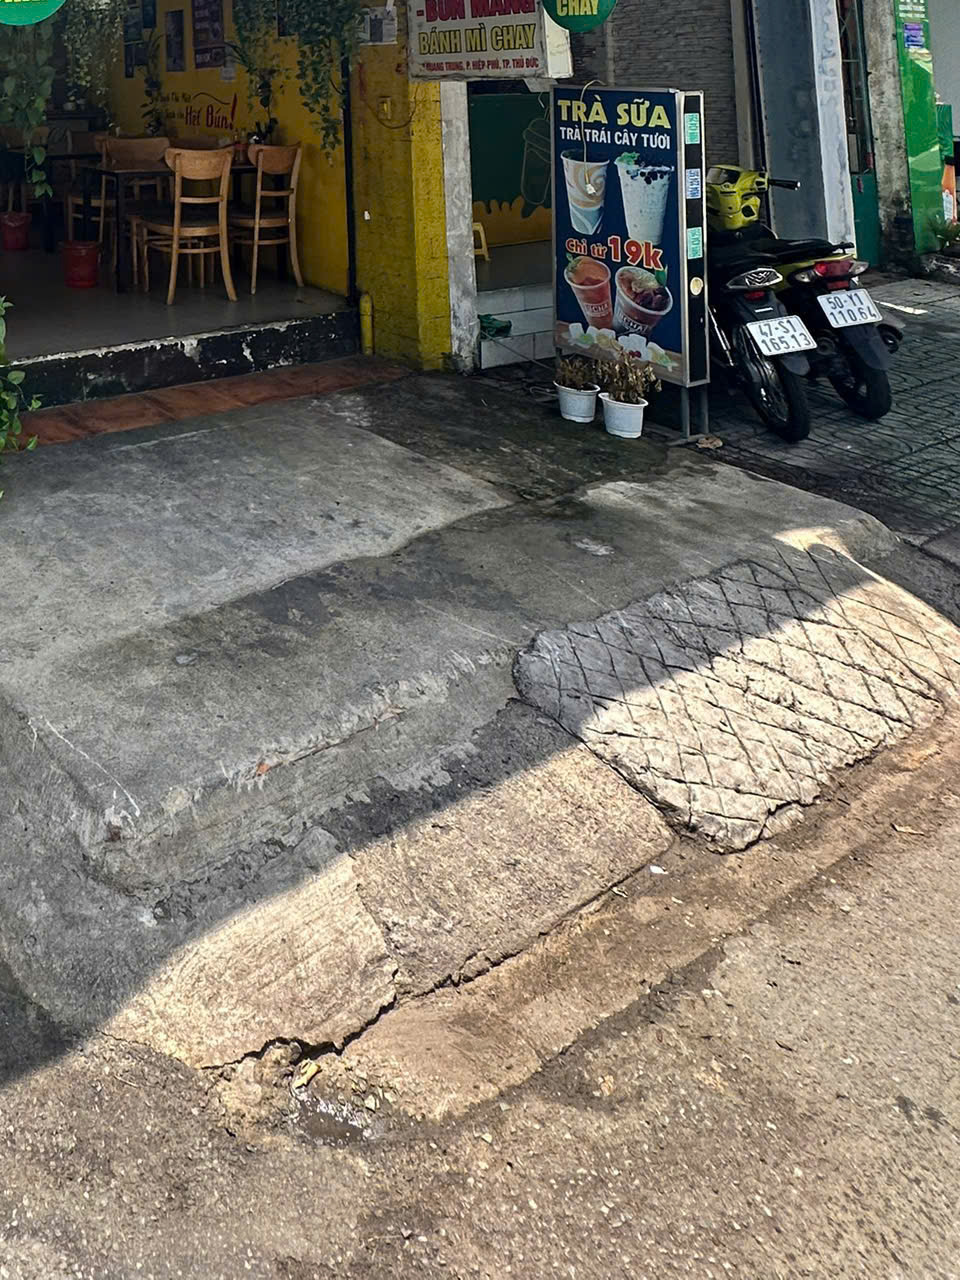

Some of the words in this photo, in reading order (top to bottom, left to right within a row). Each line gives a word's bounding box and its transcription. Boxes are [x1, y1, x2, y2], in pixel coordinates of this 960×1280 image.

[418, 26, 461, 55] BÁNH
[466, 23, 487, 52] MÌ
[491, 23, 536, 51] CHAY
[557, 94, 608, 124] TRÀ
[617, 98, 672, 129] SỮA
[560, 125, 581, 141] TRÀ
[584, 127, 611, 144] TRÁI
[614, 129, 638, 146] CÂY
[641, 132, 670, 149] TƯƠI
[608, 235, 664, 269] 19k
[826, 293, 863, 311] 50-Y1
[758, 320, 799, 338] 47-S1
[761, 332, 812, 353] 165.13
